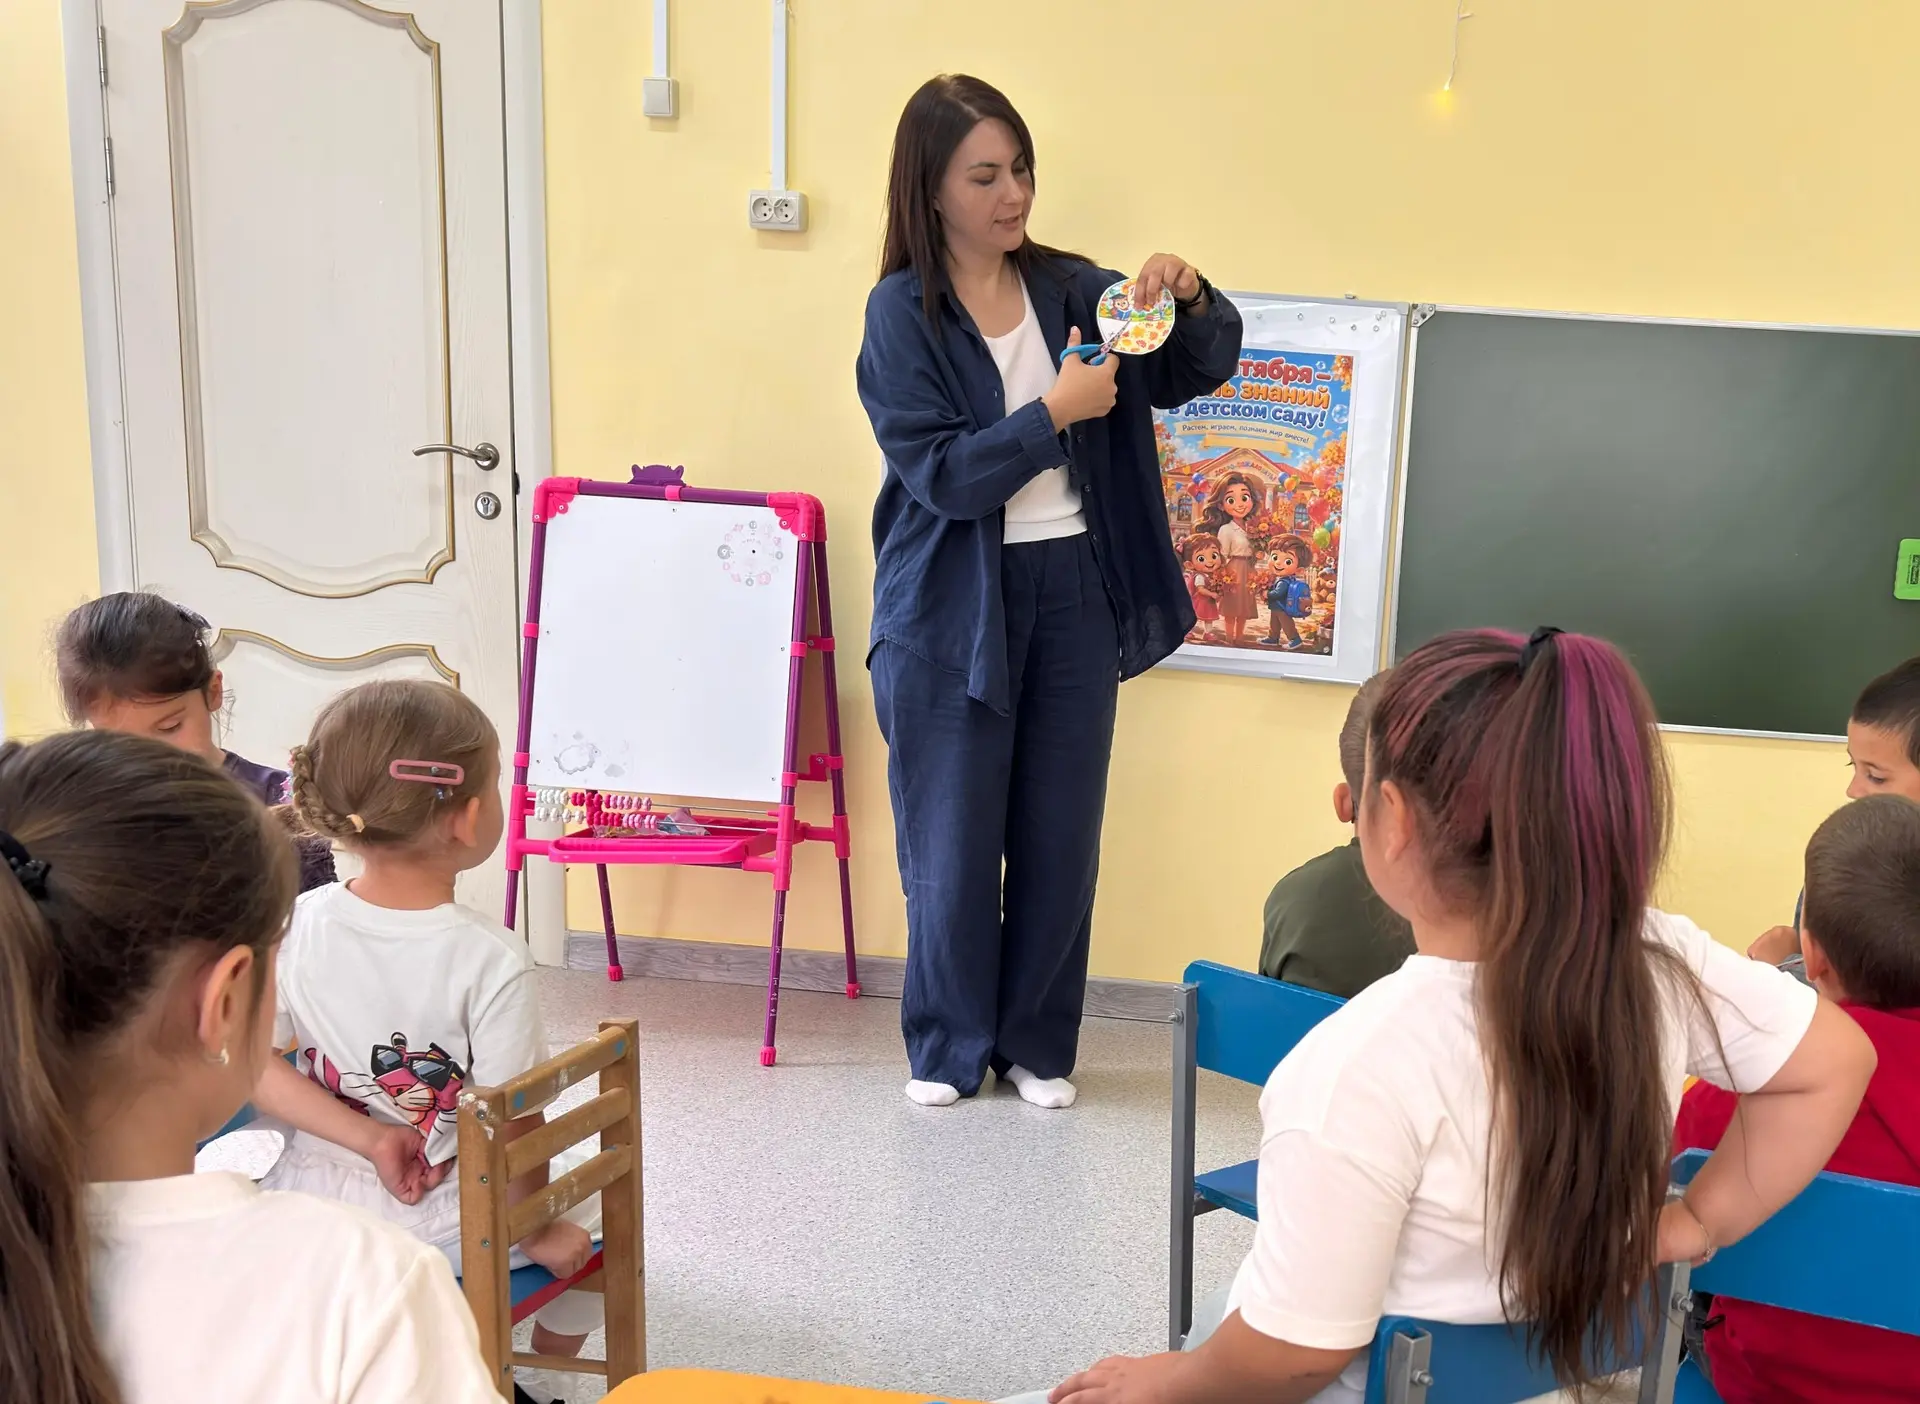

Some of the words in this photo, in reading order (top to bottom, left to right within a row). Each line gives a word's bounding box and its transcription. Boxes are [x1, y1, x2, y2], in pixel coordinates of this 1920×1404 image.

[1234, 356, 1313, 385] тября
[1240, 381, 1330, 409] знаний
[1185, 401, 1267, 419] детском
[1271, 407, 1327, 429] саду!
[1269, 429, 1283, 438] мир
